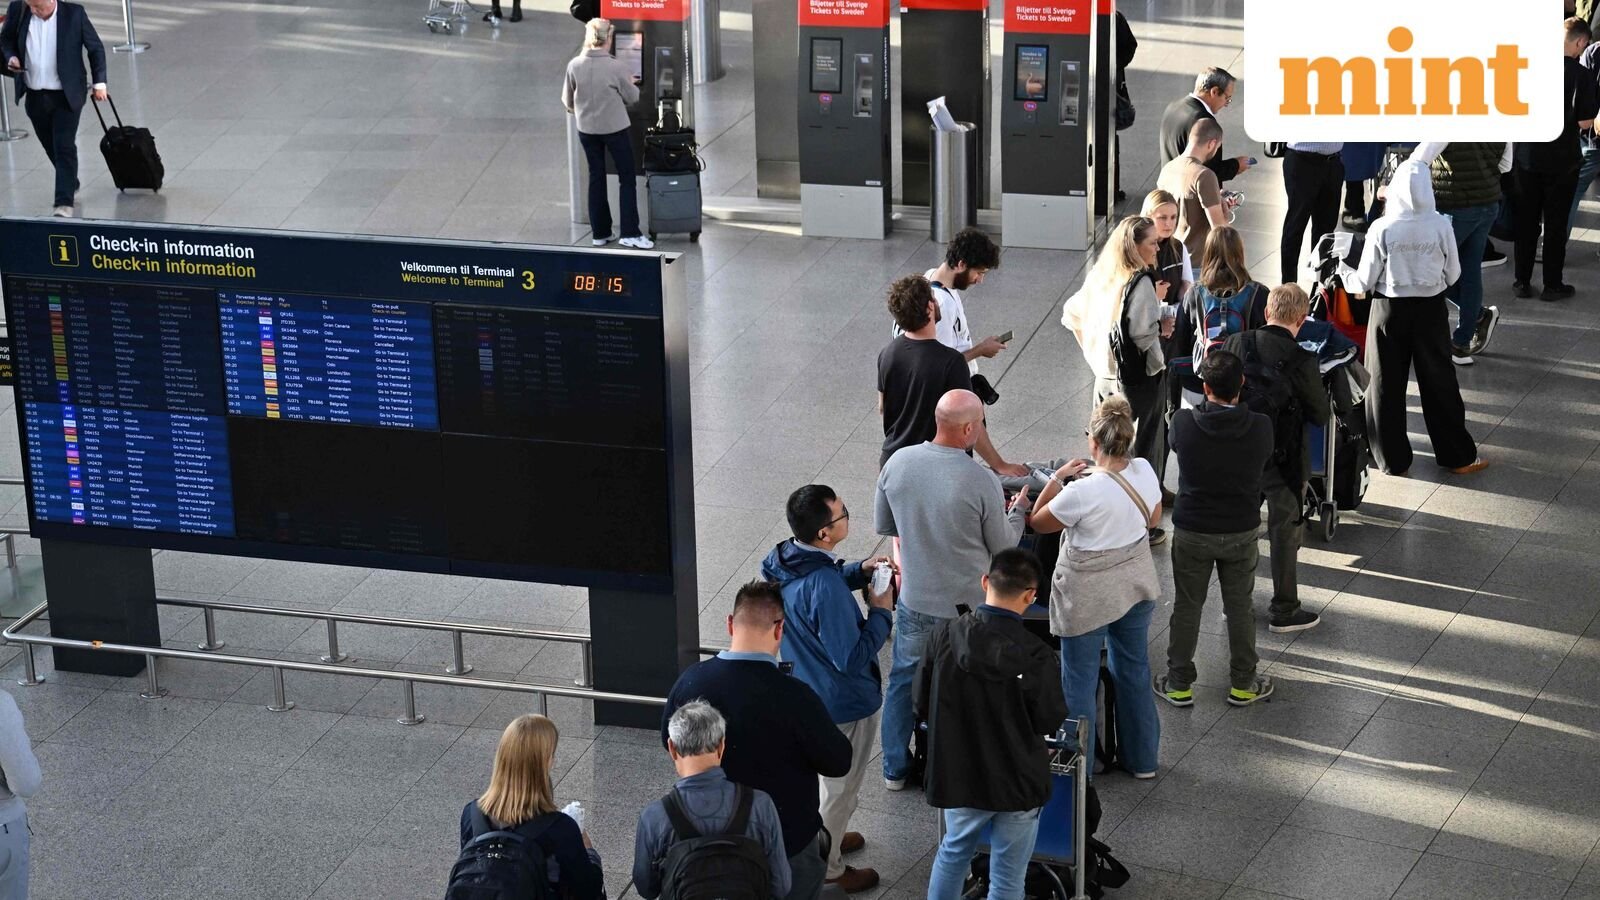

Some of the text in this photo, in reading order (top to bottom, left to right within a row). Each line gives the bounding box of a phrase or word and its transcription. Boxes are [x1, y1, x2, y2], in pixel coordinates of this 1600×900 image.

[846, 1, 868, 9] Sverige
[1016, 6, 1041, 14] Biljetter
[1053, 7, 1076, 16] Sverige
[90, 235, 254, 259] Check-in information
[92, 254, 256, 278] Check-in information
[400, 262, 515, 277] Velkommen til Terminal
[402, 273, 504, 288] Welcome to Terminal
[522, 271, 535, 290] 3
[574, 275, 622, 293] 08:15
